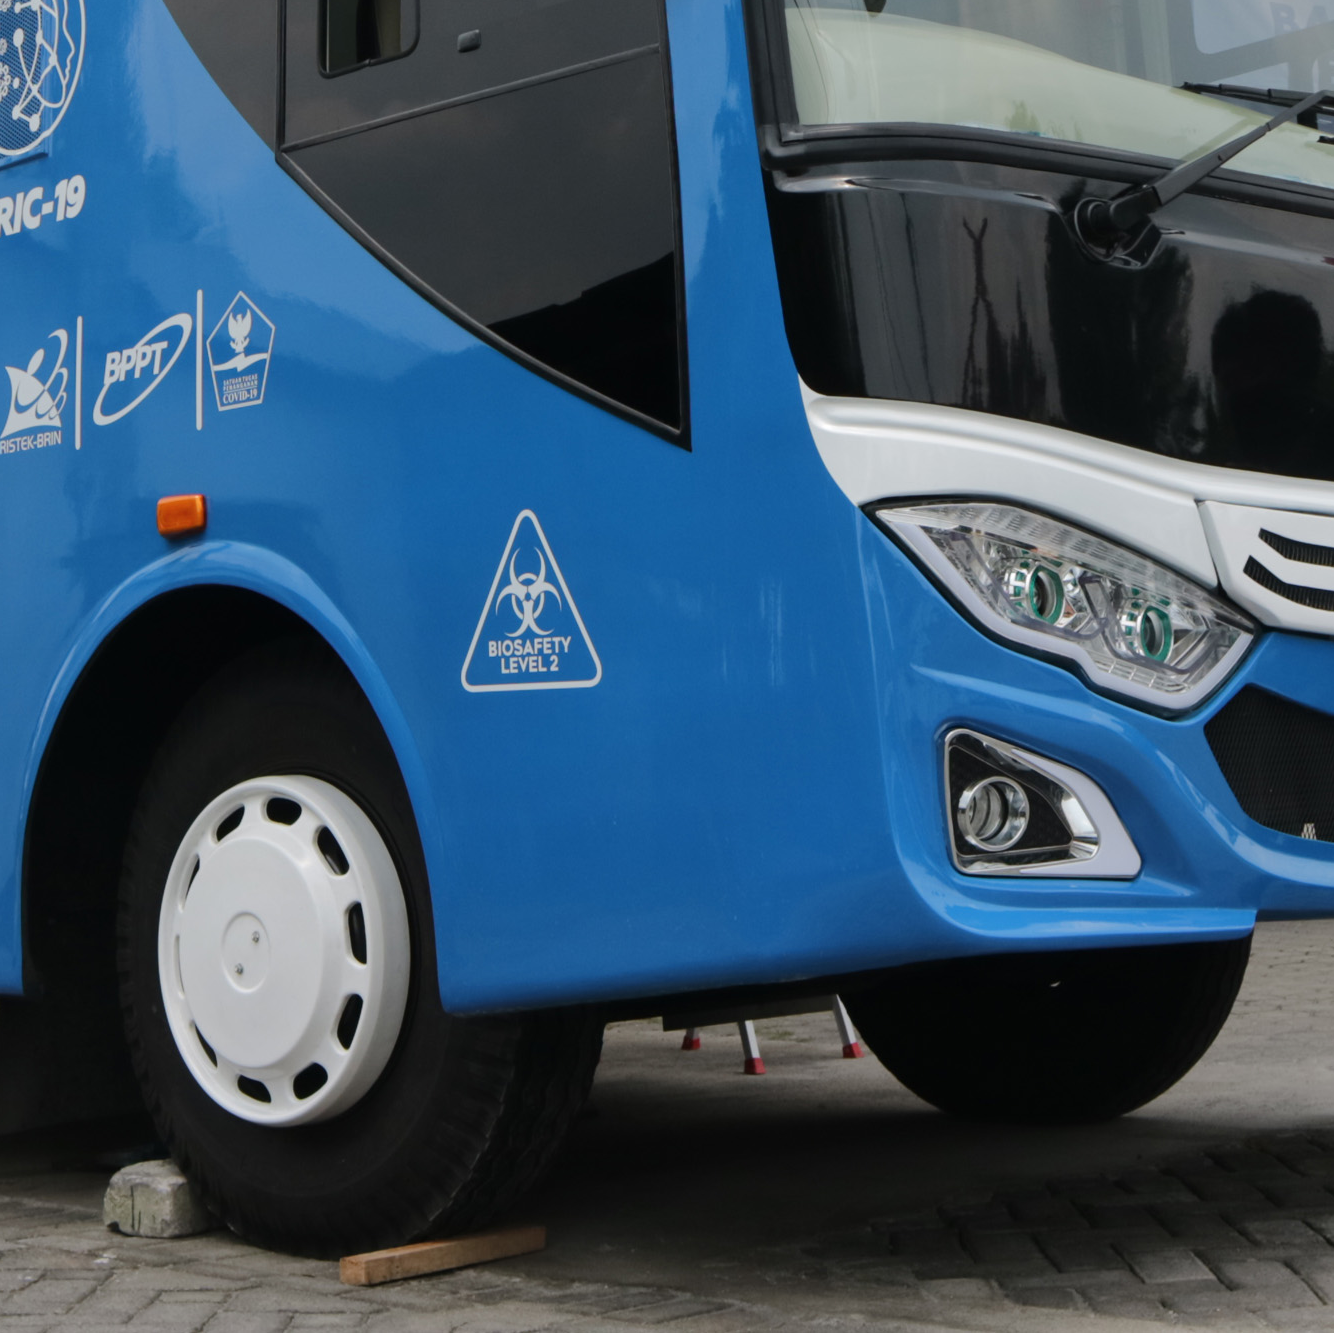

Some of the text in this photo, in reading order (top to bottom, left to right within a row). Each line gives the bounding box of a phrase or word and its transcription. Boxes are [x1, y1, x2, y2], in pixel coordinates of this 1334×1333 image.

[103, 340, 169, 386] BPPT
[223, 388, 258, 404] COVID-19
[0, 430, 62, 455] RISTEK-BRIN
[488, 635, 572, 658] BIOSAFETY
[500, 654, 560, 674] LEVEL 2
